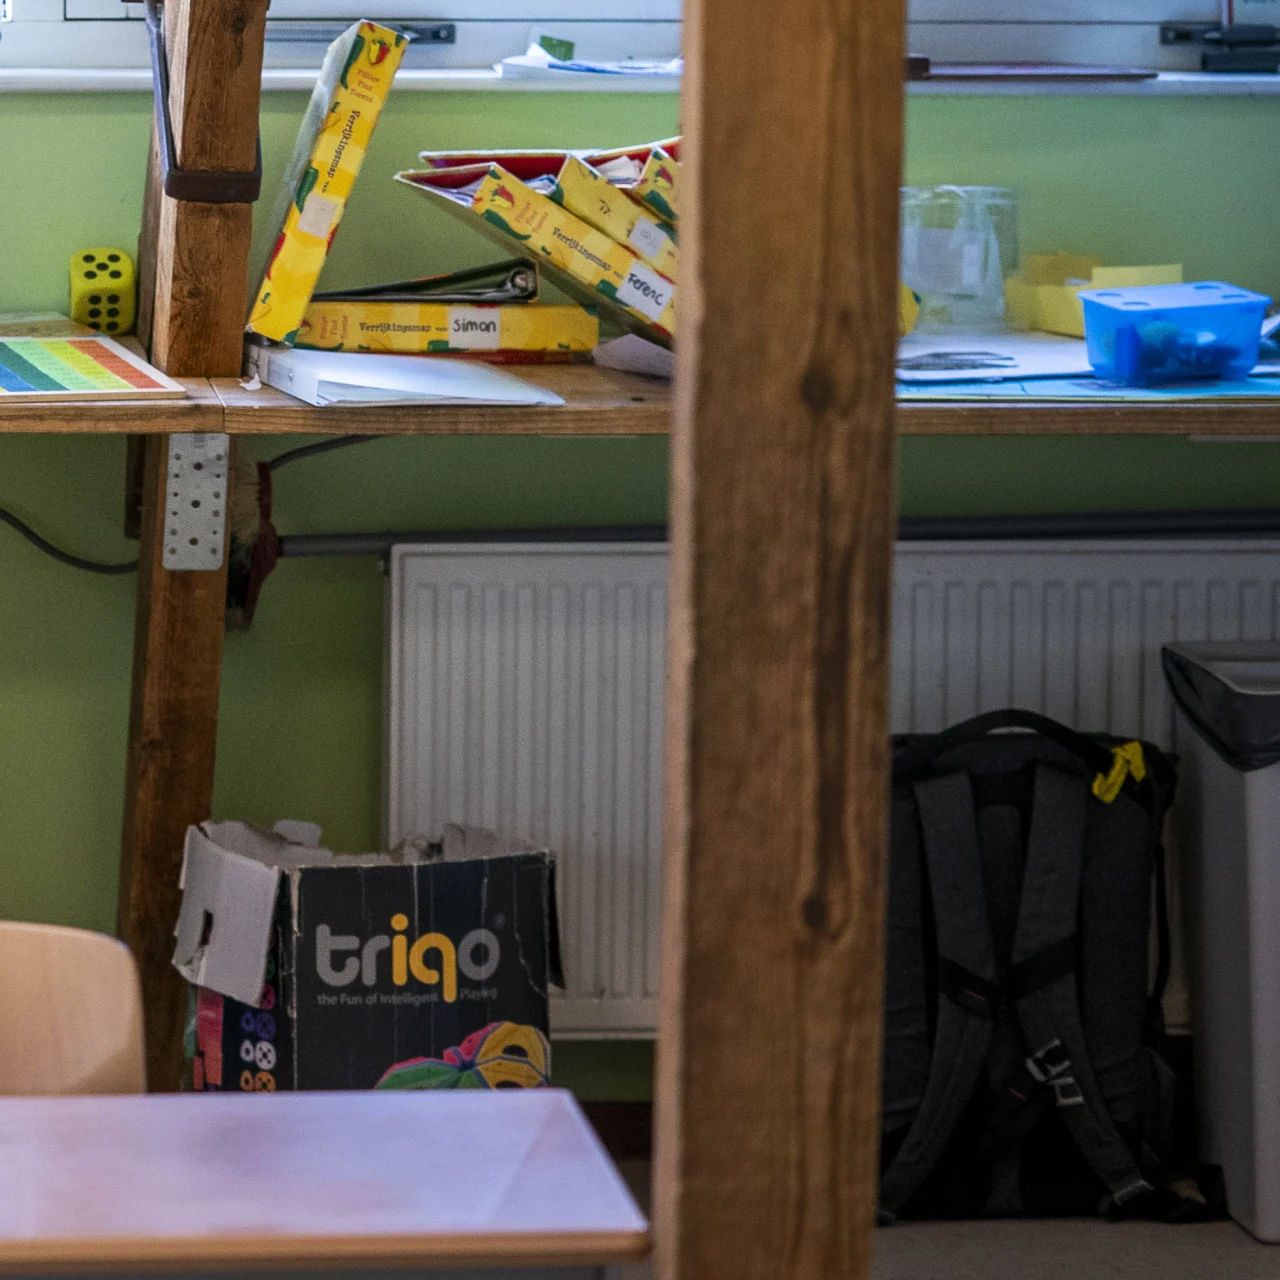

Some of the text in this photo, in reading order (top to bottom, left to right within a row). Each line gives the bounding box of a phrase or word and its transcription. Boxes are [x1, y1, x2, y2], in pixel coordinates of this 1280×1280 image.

[328, 110, 361, 178] Verrijkingsmap
[452, 319, 497, 333] Simon
[317, 993, 337, 1005] the
[340, 993, 362, 1005] Fun
[365, 992, 379, 1005] of
